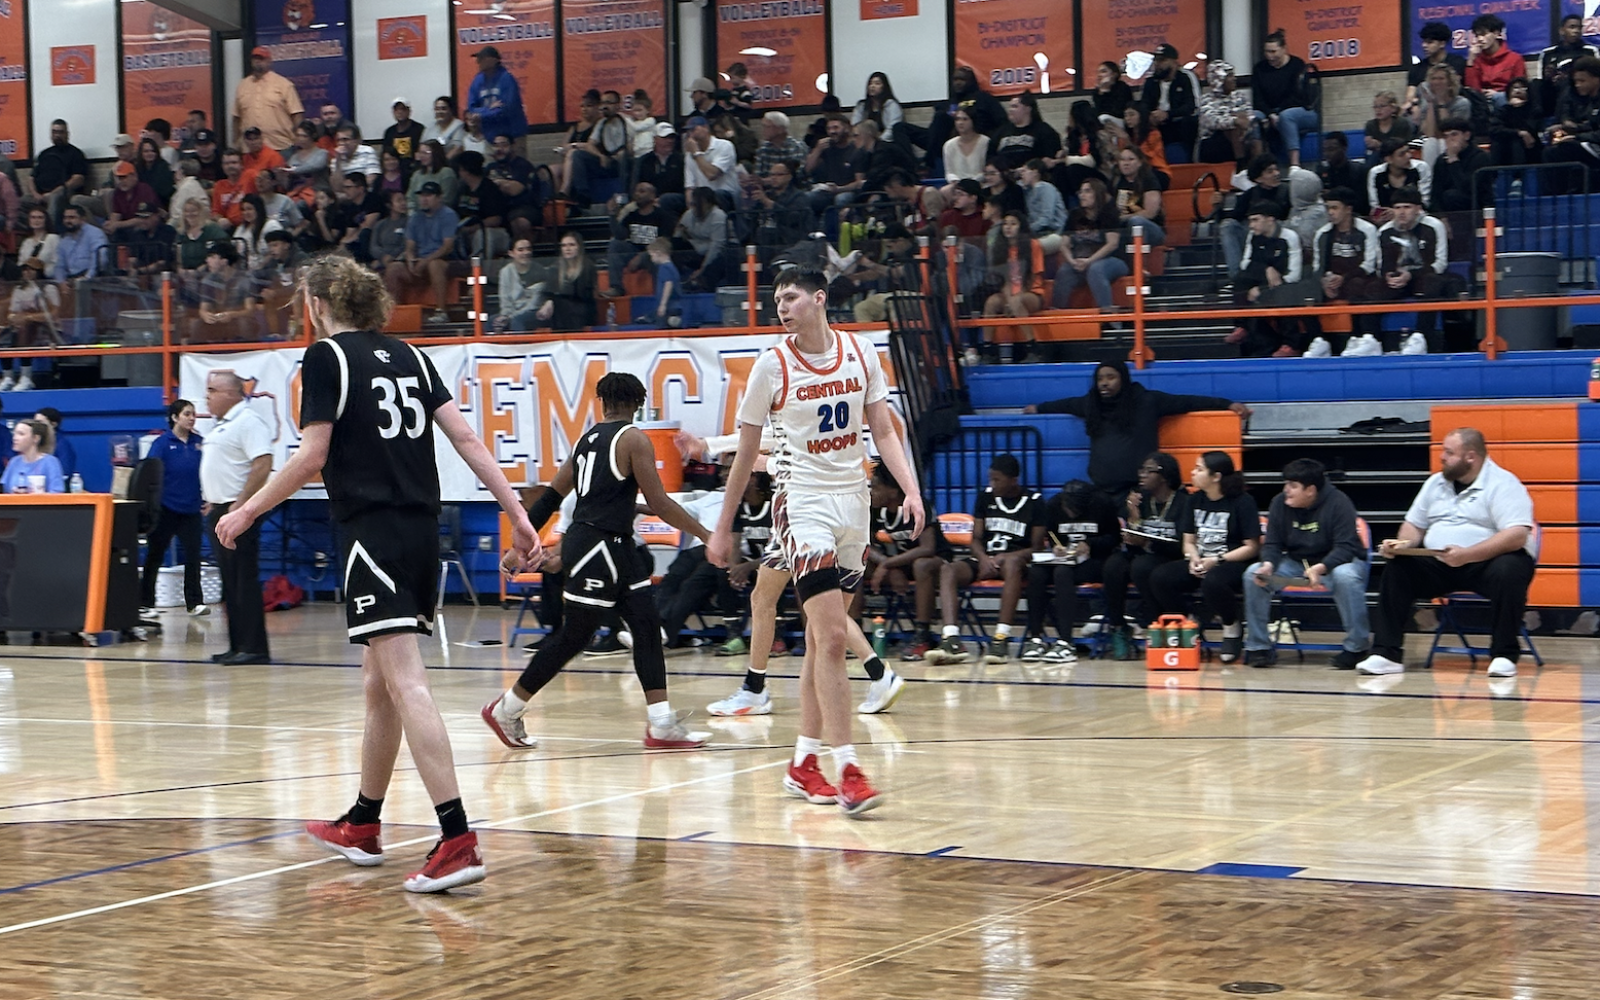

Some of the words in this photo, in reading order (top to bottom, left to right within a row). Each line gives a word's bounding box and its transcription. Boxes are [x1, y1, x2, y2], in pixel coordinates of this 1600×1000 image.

[562, 10, 663, 35] VOLLEYBALL
[719, 0, 824, 23] VOLLEYBALL
[1304, 6, 1362, 19] BI-DISTRICT
[457, 22, 554, 45] VOLLEYBALL
[978, 16, 1048, 34] BI-DISTRICT
[980, 33, 1045, 50] CHAMPION
[1308, 38, 1360, 60] 2018
[123, 49, 210, 71] BASKETBALL
[990, 66, 1036, 87] 2015
[796, 377, 862, 400] CENTRAL
[371, 376, 426, 439] 35
[817, 401, 849, 432] 20
[807, 432, 857, 454] HOOPS
[583, 578, 605, 591] P
[354, 595, 376, 614] P
[1167, 636, 1180, 647] G
[1163, 651, 1179, 666] G
